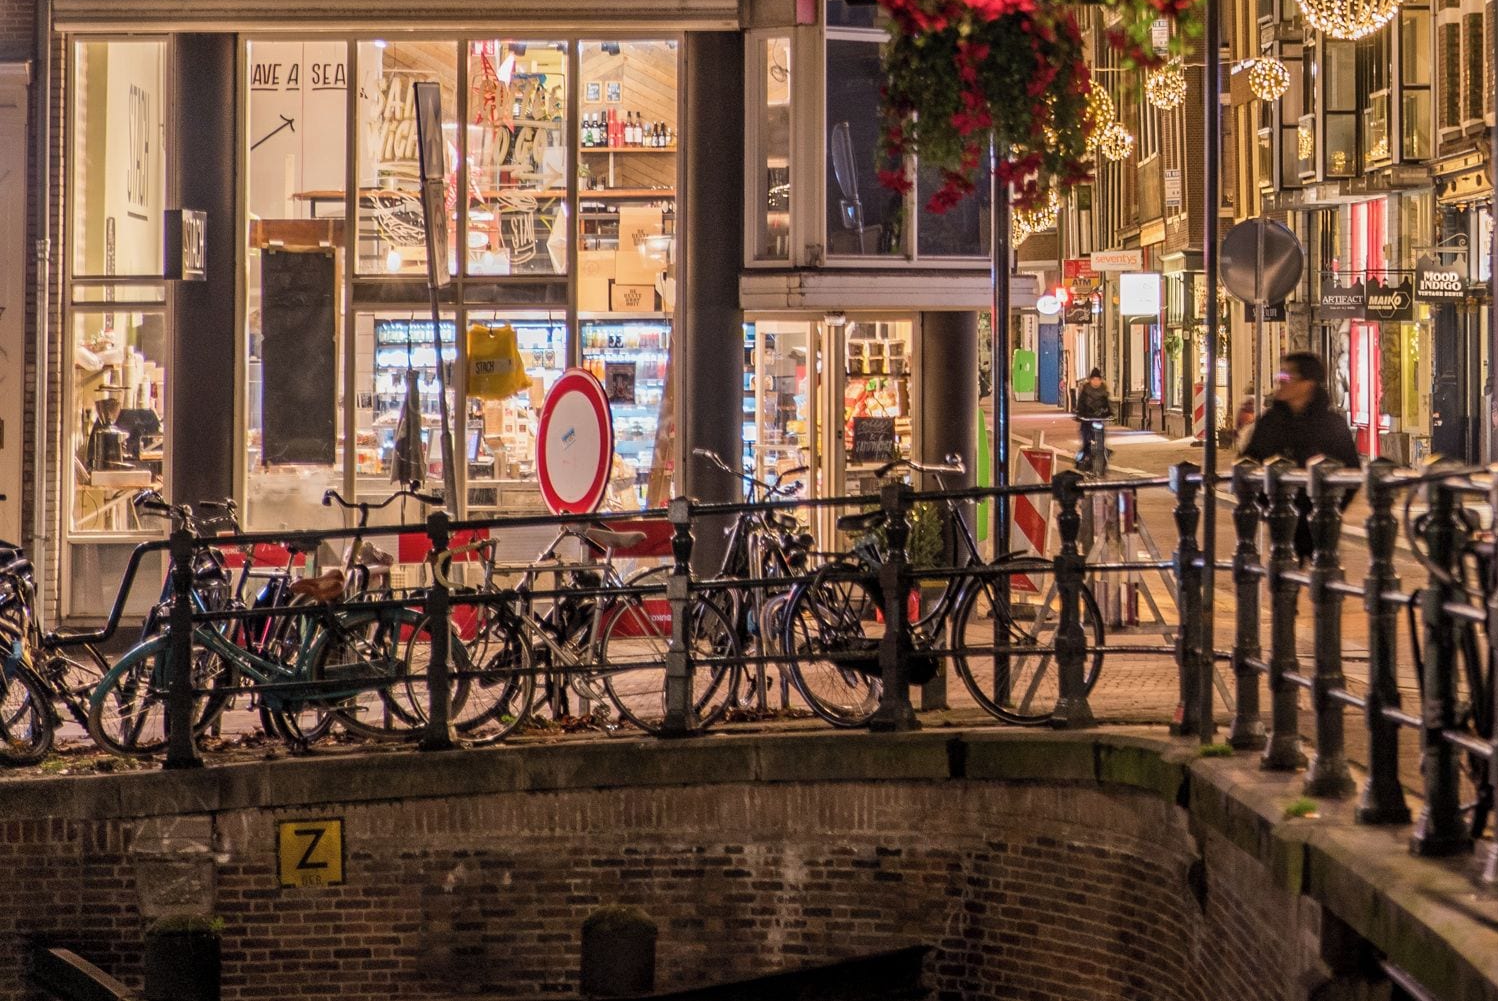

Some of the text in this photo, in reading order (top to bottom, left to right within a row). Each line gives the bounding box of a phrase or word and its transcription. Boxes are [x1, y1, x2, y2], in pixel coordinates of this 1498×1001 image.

[287, 63, 299, 85] A
[312, 63, 346, 85] SEA
[1096, 255, 1137, 265] seventys
[1424, 271, 1459, 282] MOOD
[1420, 280, 1462, 291] INDIGO
[1322, 295, 1363, 303] ARTIFACT
[1368, 293, 1402, 306] MAIKO
[475, 360, 495, 375] STACH
[294, 828, 328, 869] Z
